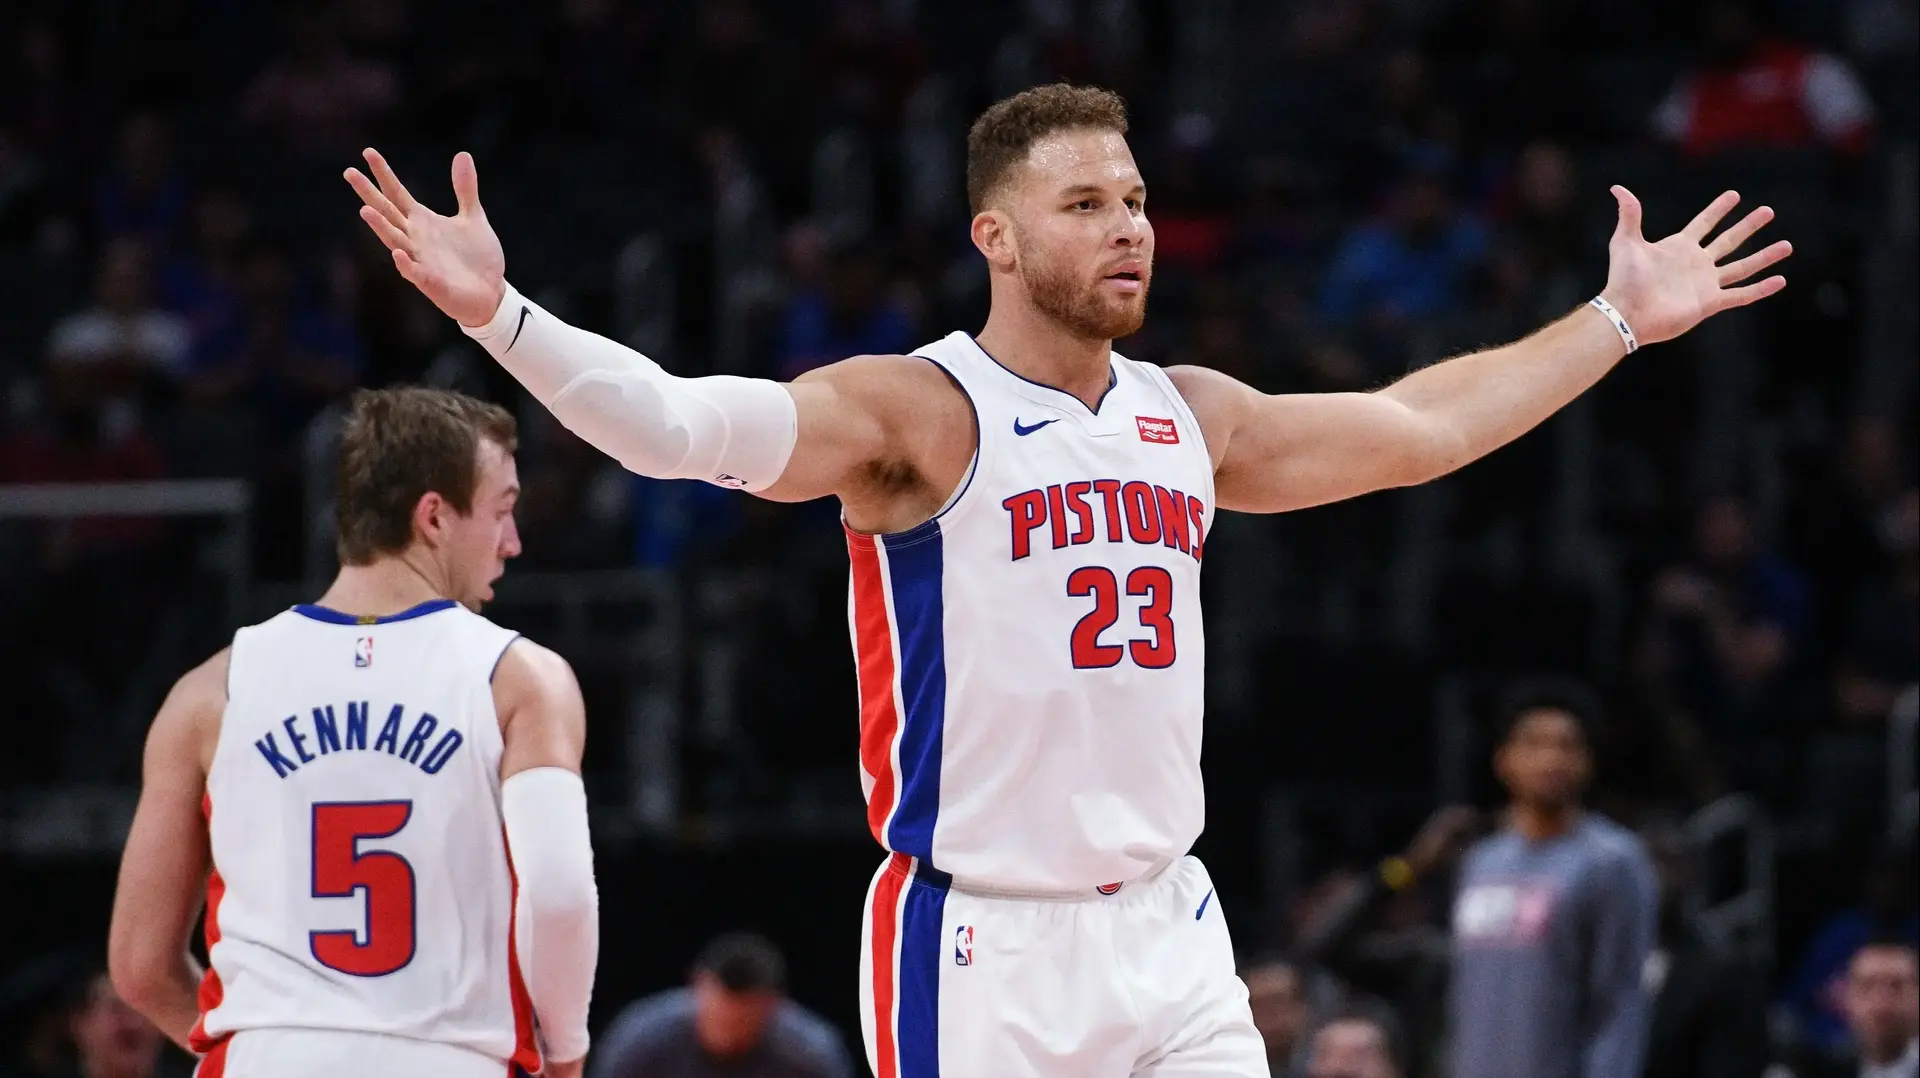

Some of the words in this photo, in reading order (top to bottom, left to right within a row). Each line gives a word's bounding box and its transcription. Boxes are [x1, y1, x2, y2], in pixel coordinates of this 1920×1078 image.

[1002, 479, 1204, 563] PISTONS
[1066, 566, 1177, 669] 23
[254, 701, 464, 779] KENNARD
[309, 799, 416, 977] 5
